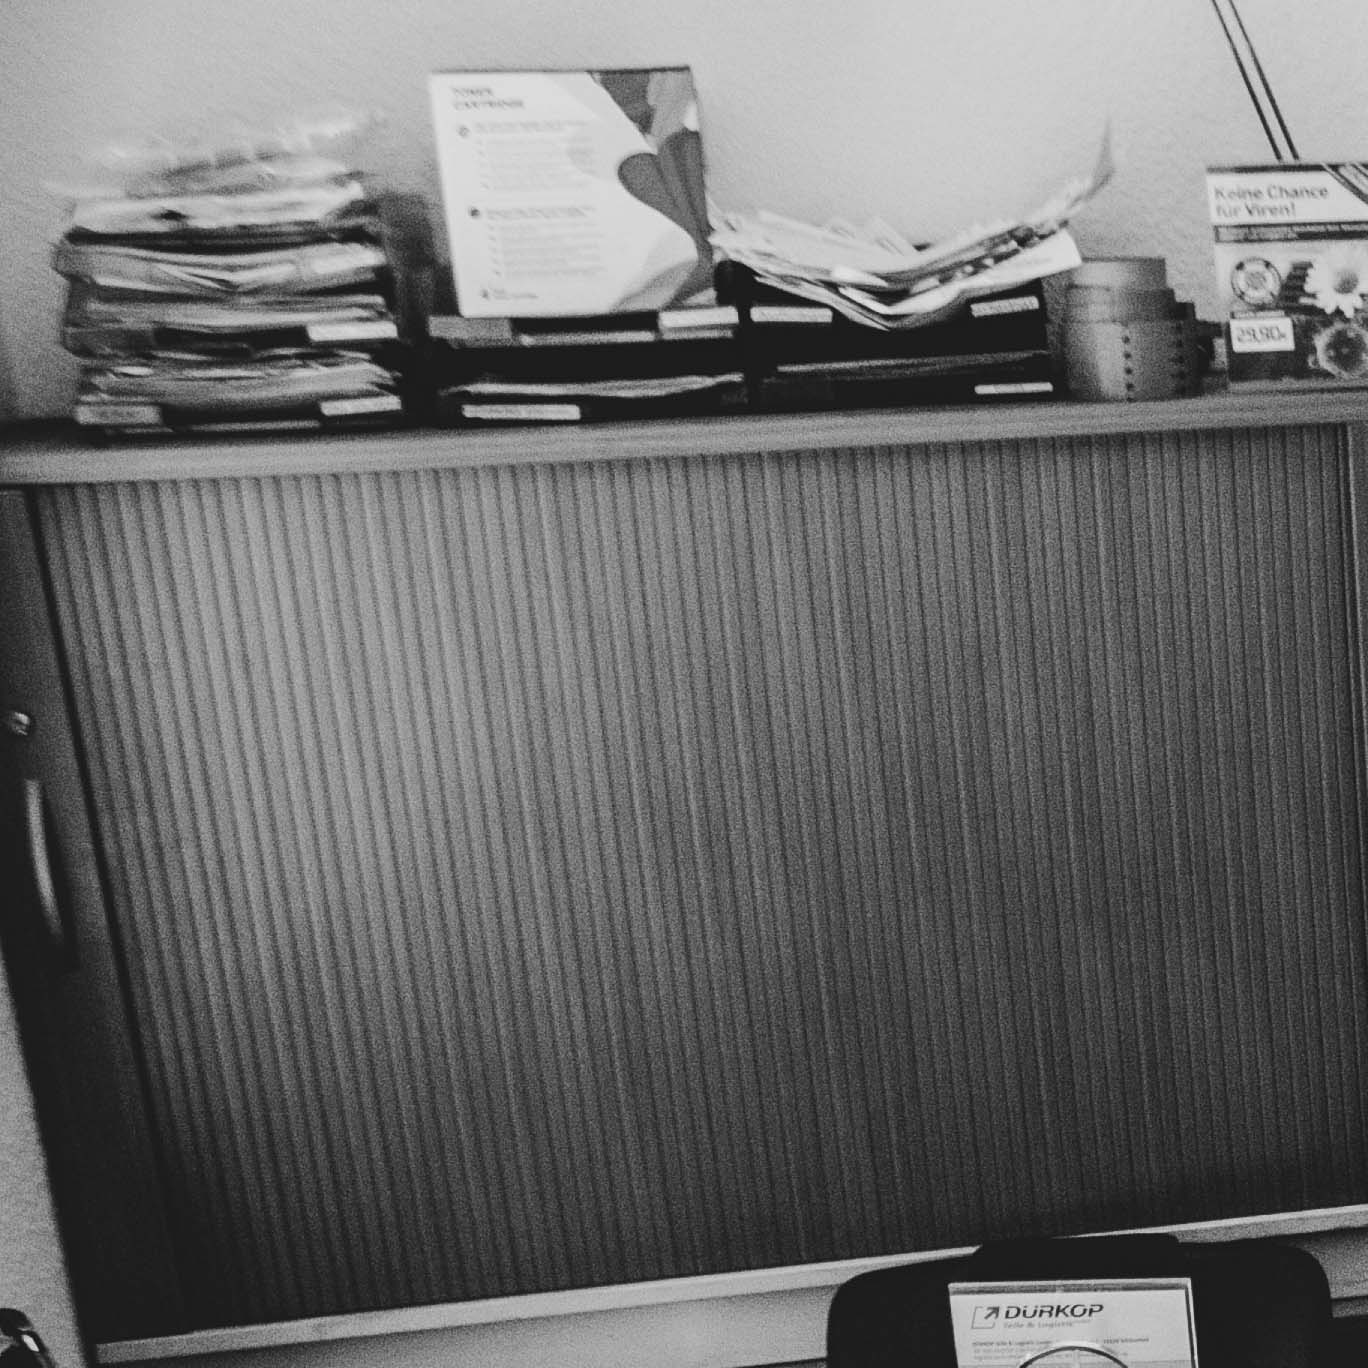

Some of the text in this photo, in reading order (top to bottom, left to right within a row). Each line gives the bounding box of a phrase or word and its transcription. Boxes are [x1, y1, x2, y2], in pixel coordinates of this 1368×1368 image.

[1214, 184, 1330, 201] Keine Chance
[1244, 201, 1296, 217] Viren!
